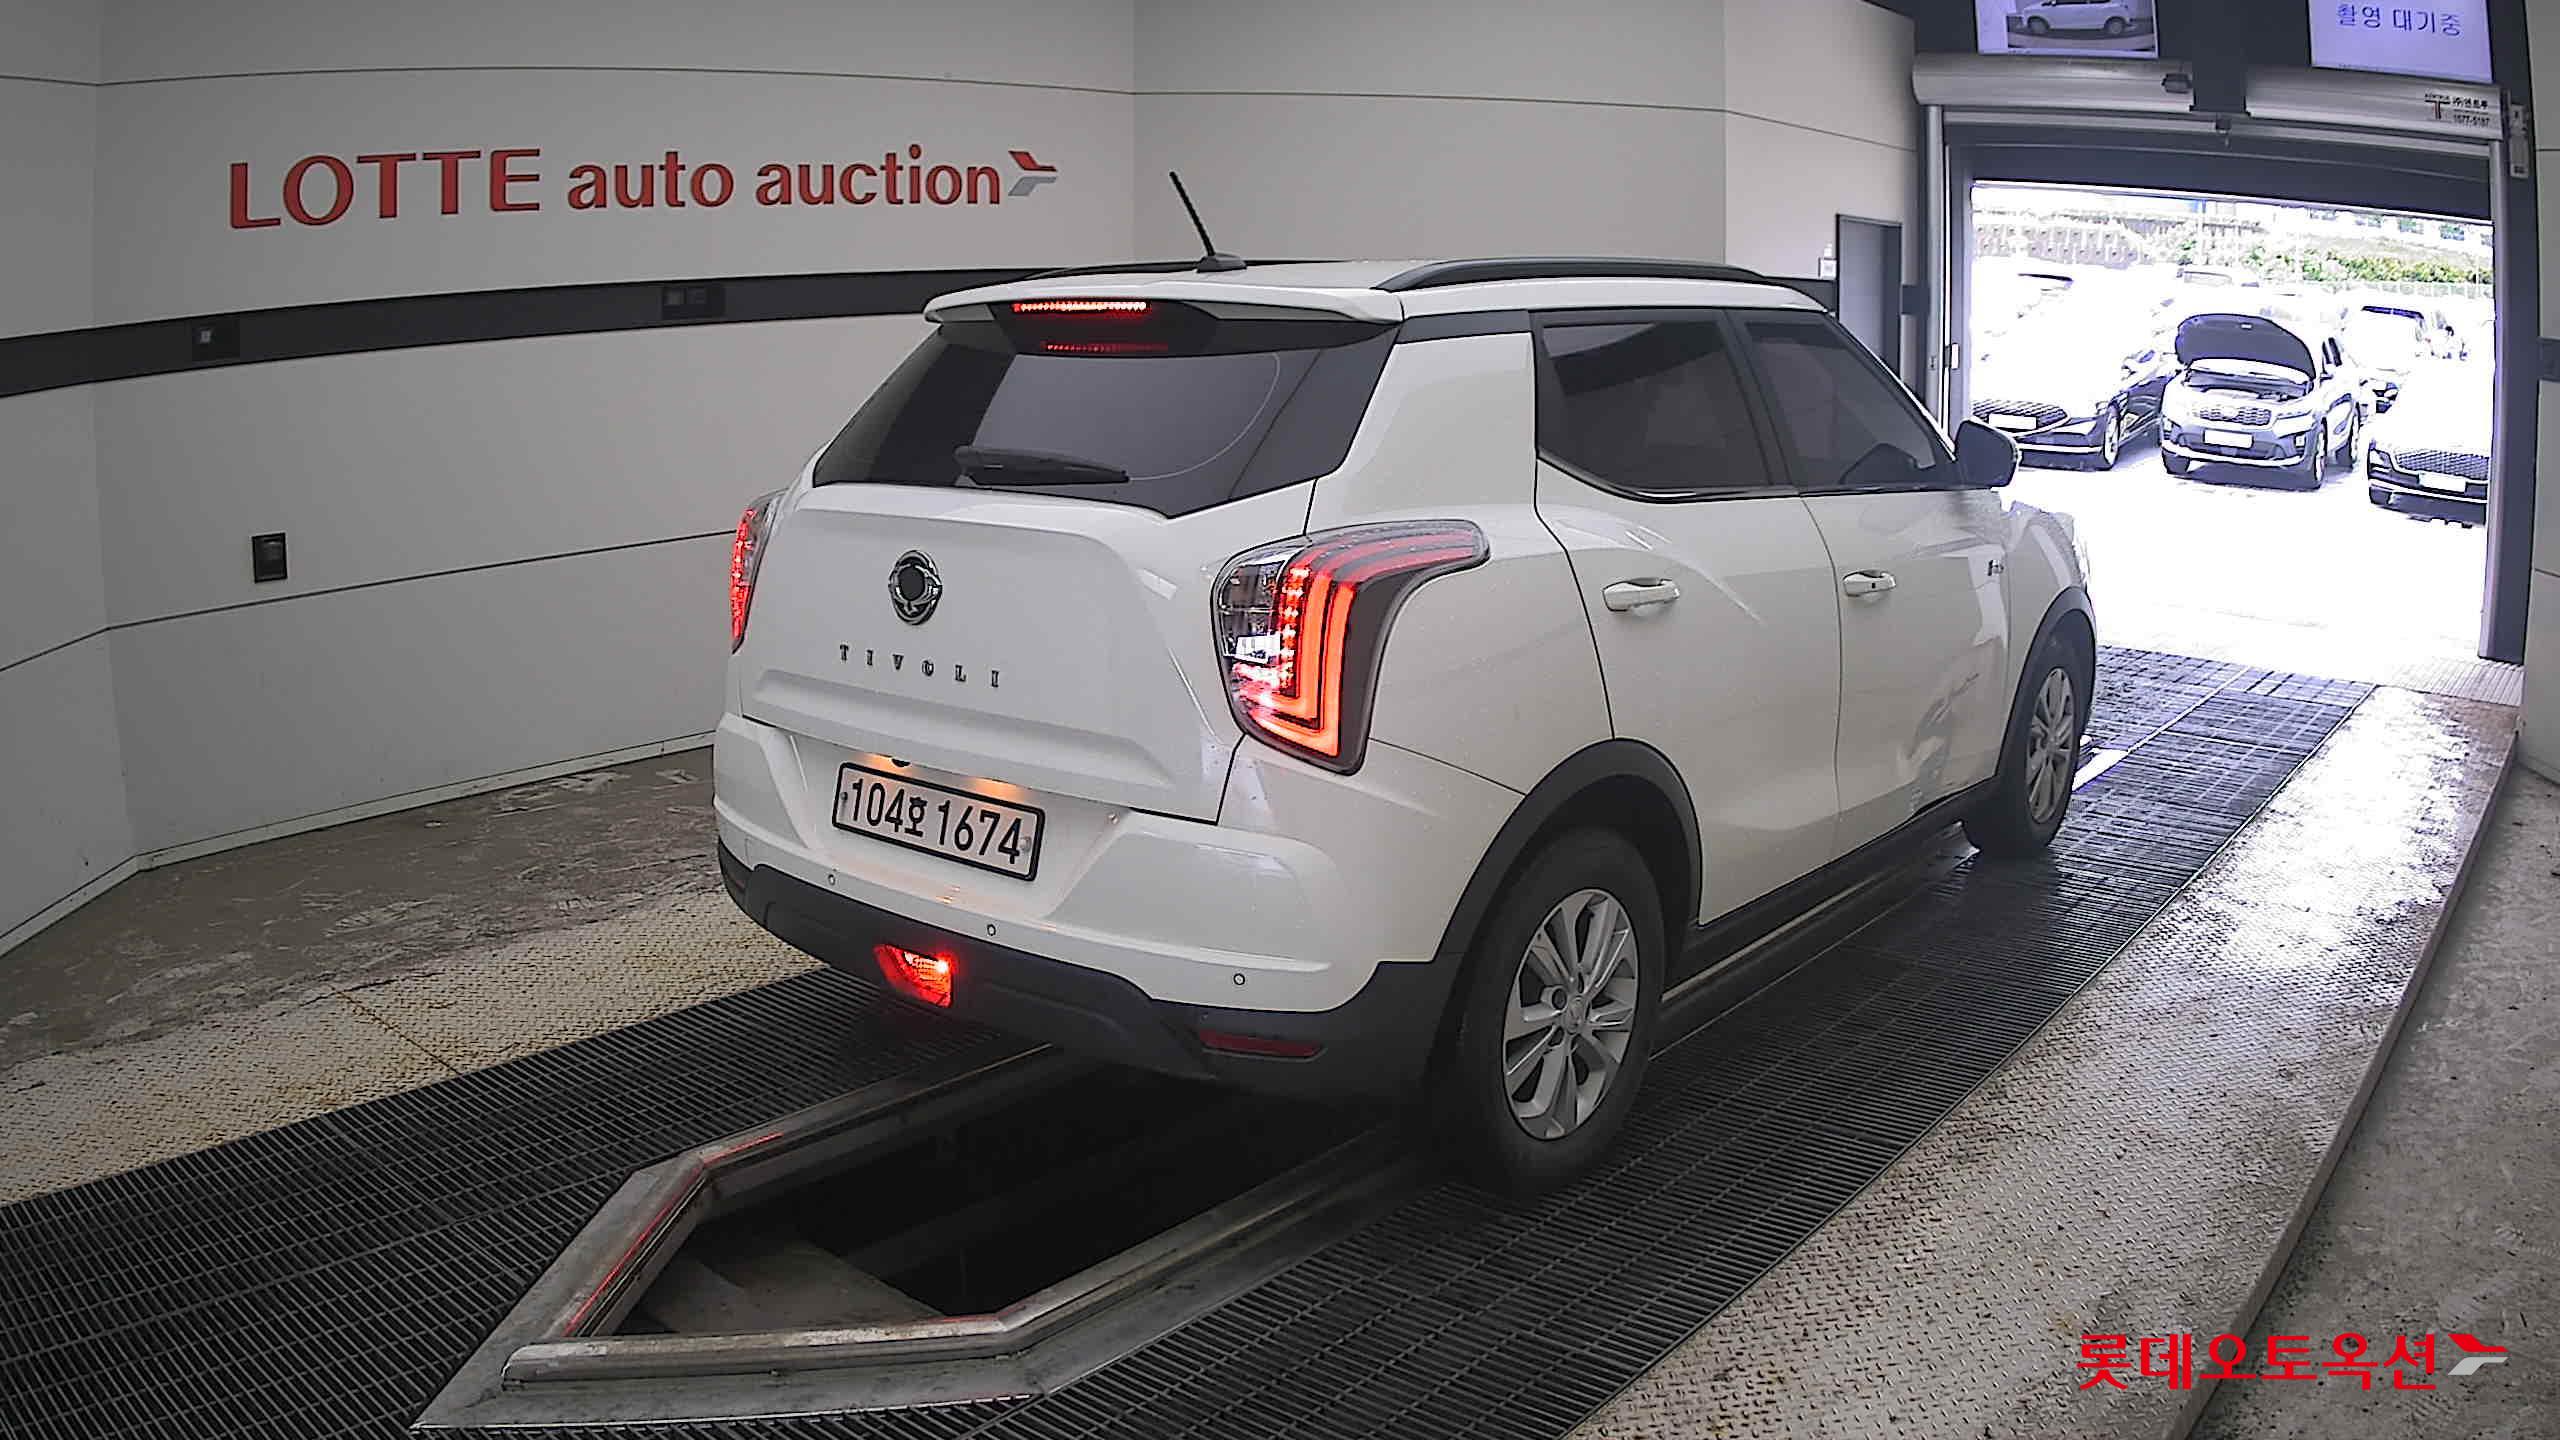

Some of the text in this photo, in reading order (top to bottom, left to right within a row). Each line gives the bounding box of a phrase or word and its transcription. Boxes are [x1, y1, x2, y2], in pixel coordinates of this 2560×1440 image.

[2337, 4, 2461, 37] 촬영 대기중
[230, 143, 1001, 229] LOTTE auto auction
[839, 643, 1000, 688] TIVOLI
[852, 778, 1022, 865] 104호 1674
